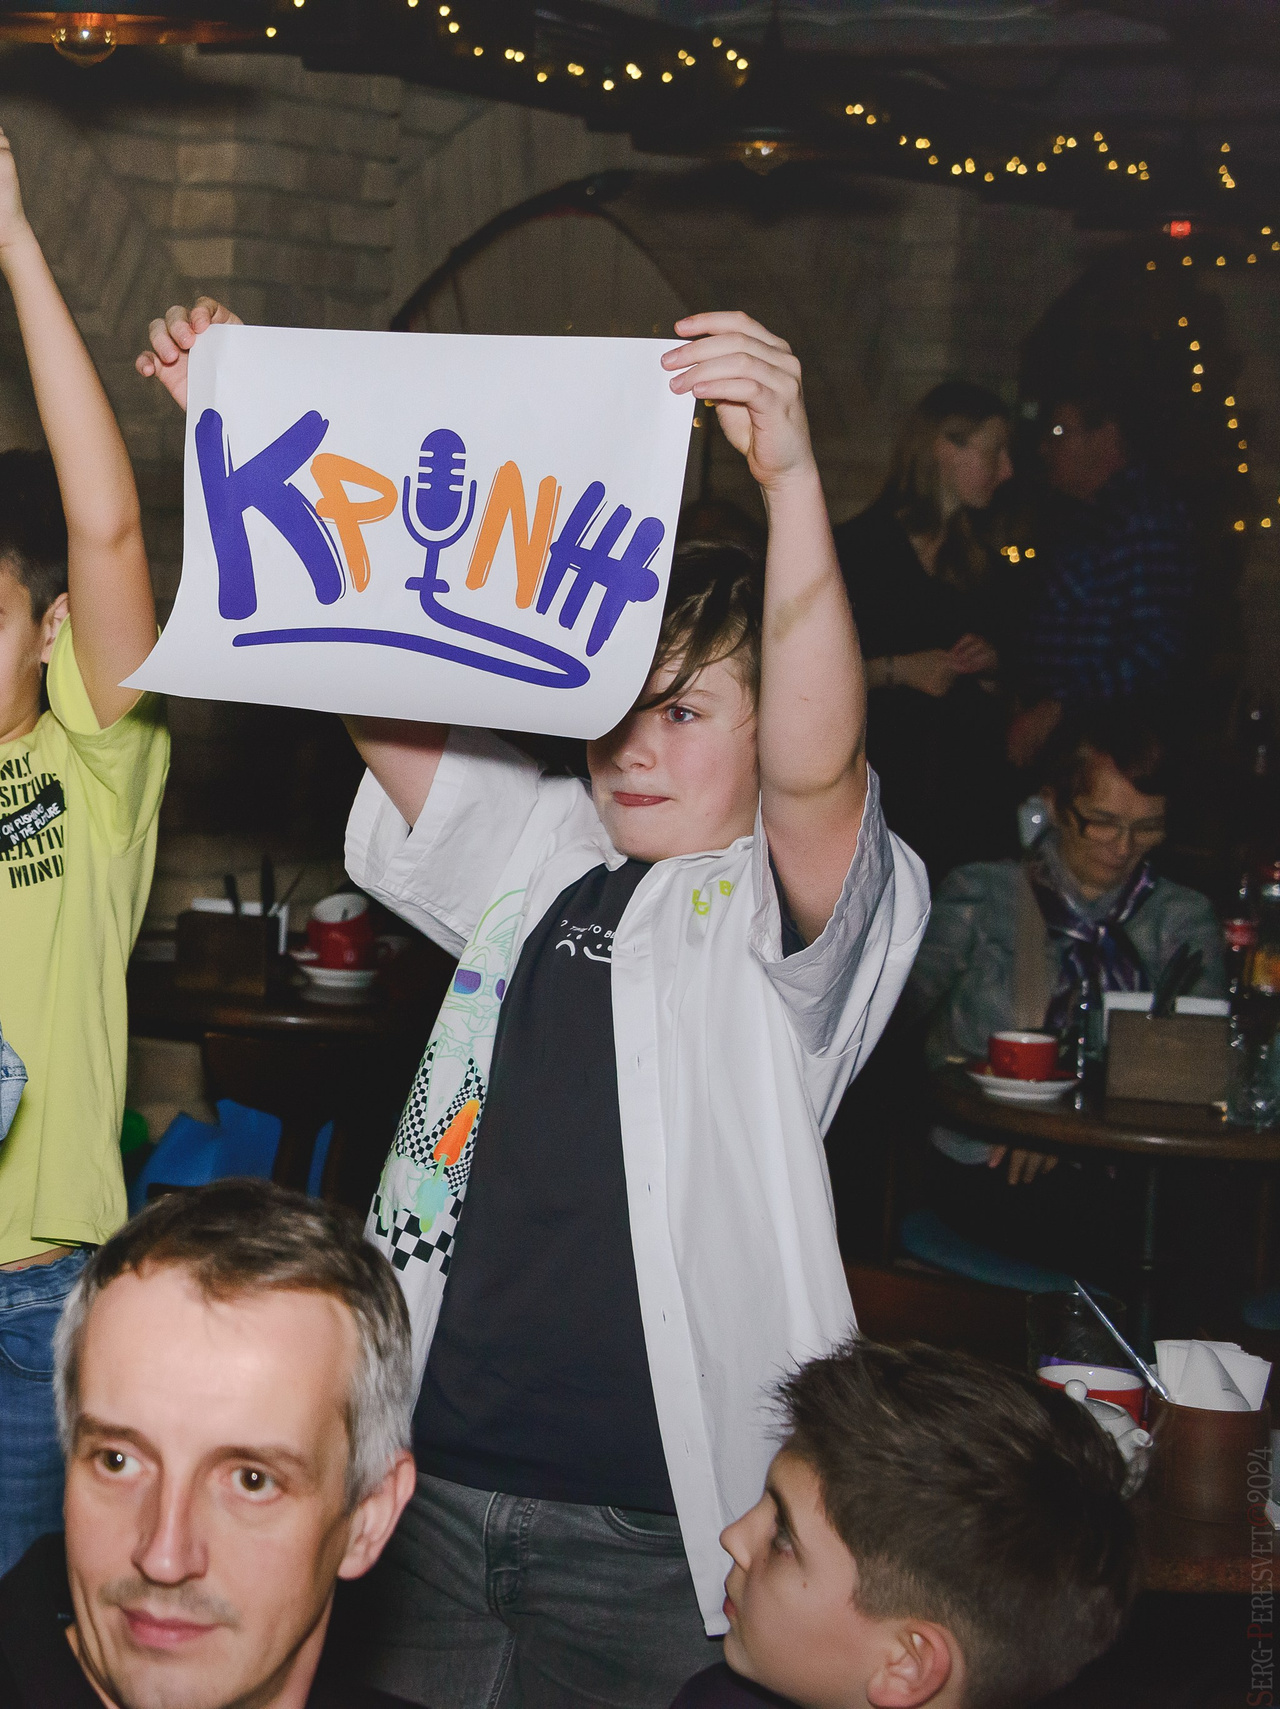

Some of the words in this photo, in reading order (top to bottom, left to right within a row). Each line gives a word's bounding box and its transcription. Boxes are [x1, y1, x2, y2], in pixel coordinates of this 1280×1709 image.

[1, 821, 15, 836] ON
[13, 803, 45, 830] PUSHING
[9, 832, 20, 845] IN
[18, 823, 36, 839] THE
[34, 802, 62, 830] FUTURE
[8, 854, 64, 889] MIND
